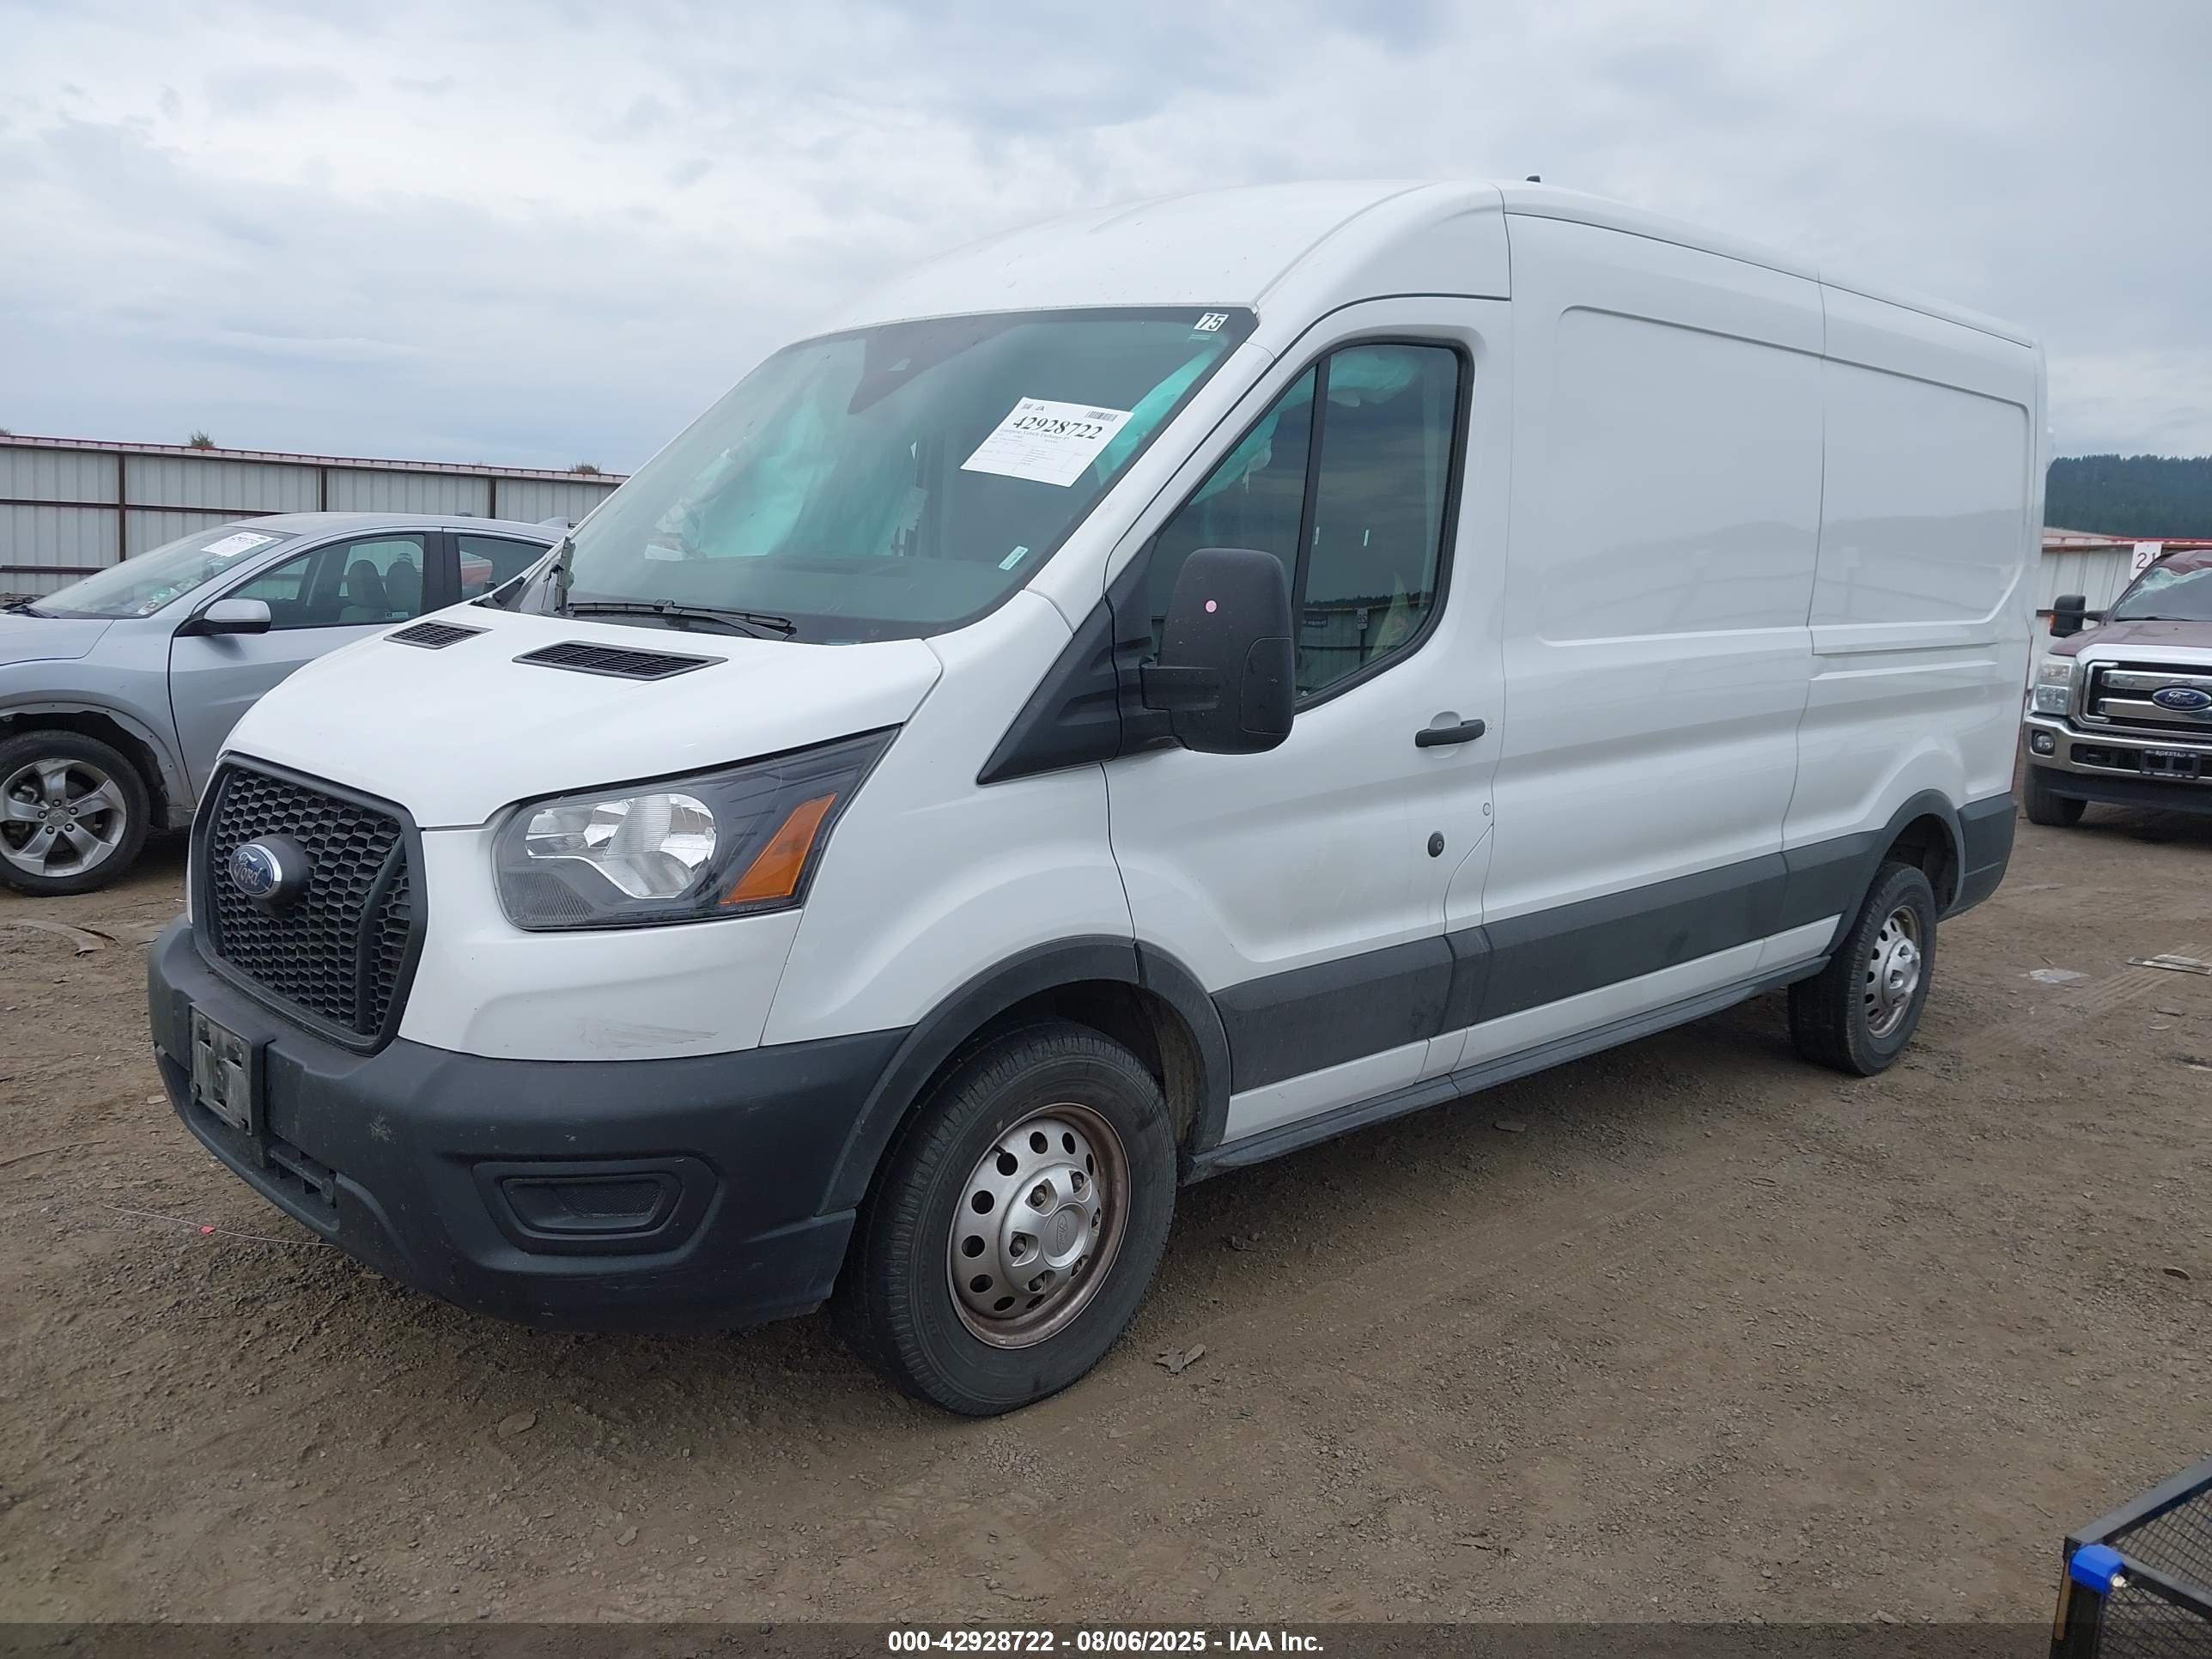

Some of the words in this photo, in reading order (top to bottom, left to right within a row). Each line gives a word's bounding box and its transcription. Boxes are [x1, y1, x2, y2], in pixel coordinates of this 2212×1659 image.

[1199, 314, 1226, 330] 75
[1013, 416, 1103, 440] 42928722
[2166, 690, 2198, 704] Ford
[234, 851, 263, 886] Ford
